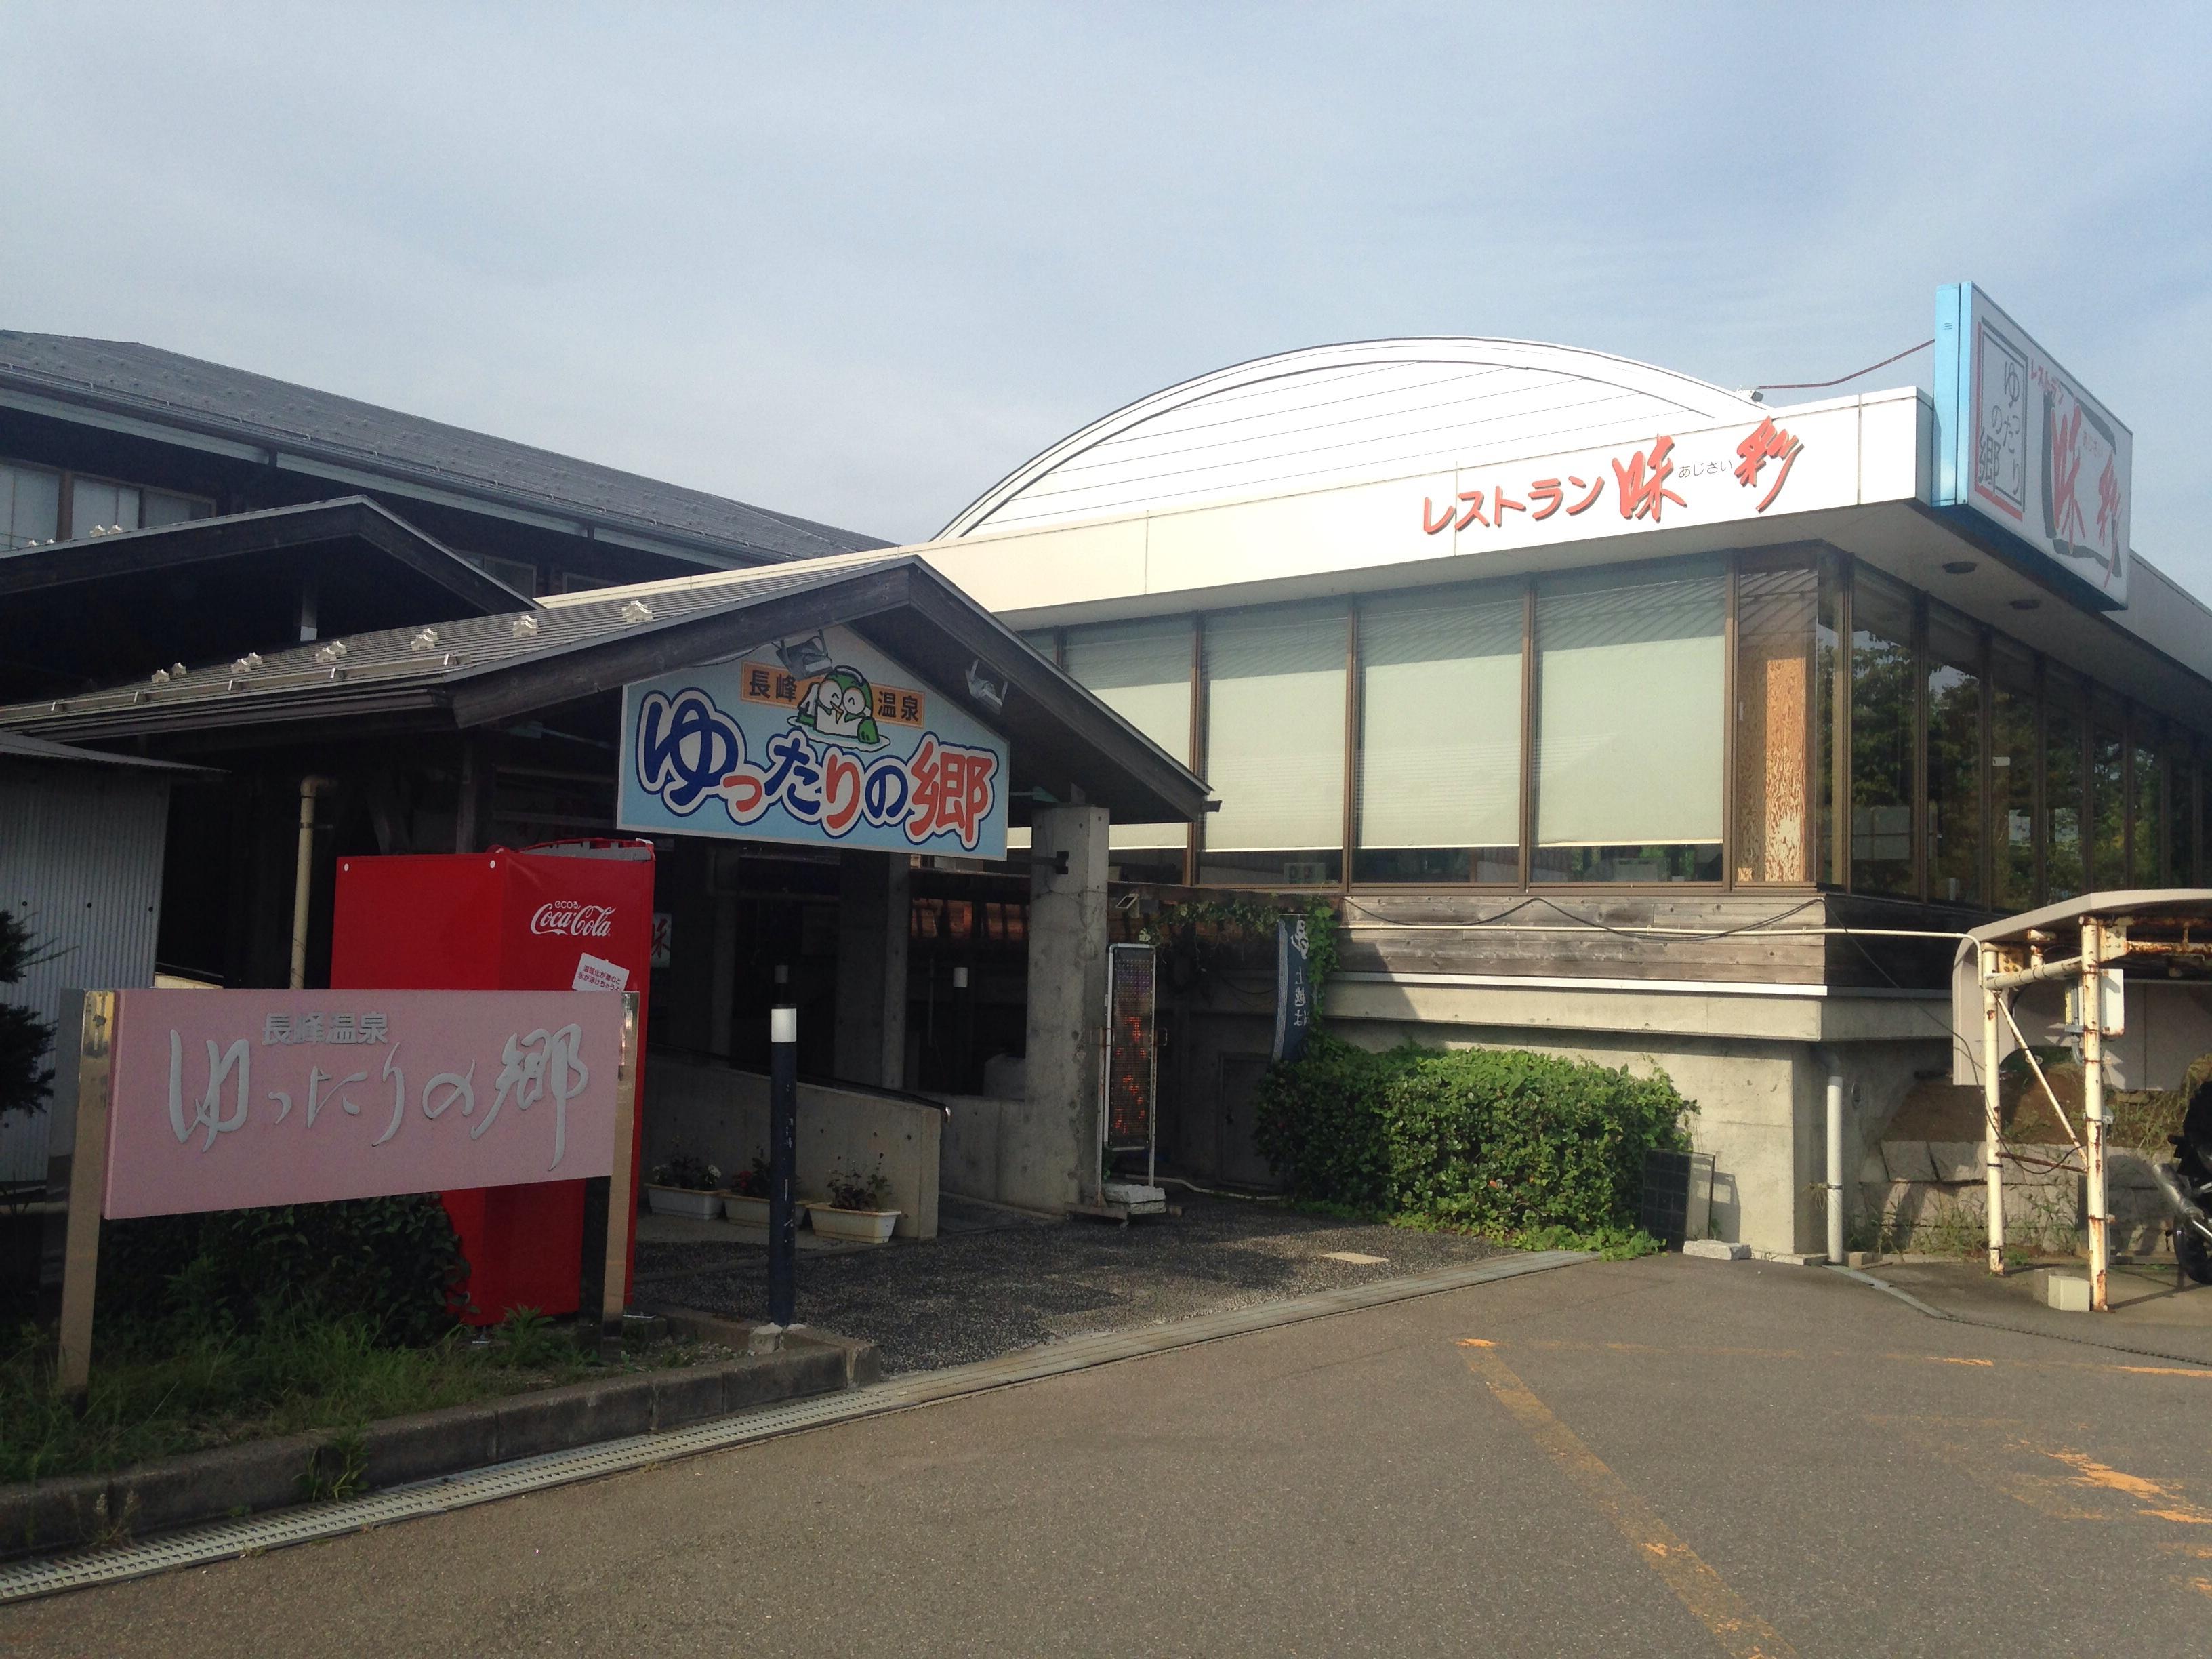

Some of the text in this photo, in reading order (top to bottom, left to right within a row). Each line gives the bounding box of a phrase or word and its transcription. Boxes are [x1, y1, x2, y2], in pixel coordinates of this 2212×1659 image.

[1422, 476, 1605, 535] レストラン
[1678, 458, 1734, 478] あじさい
[639, 693, 996, 847] ゆったりの郷
[531, 903, 616, 937] Coca-Cola
[262, 1012, 388, 1046] 長峰温泉
[168, 1023, 589, 1172] ゆったりの郷
